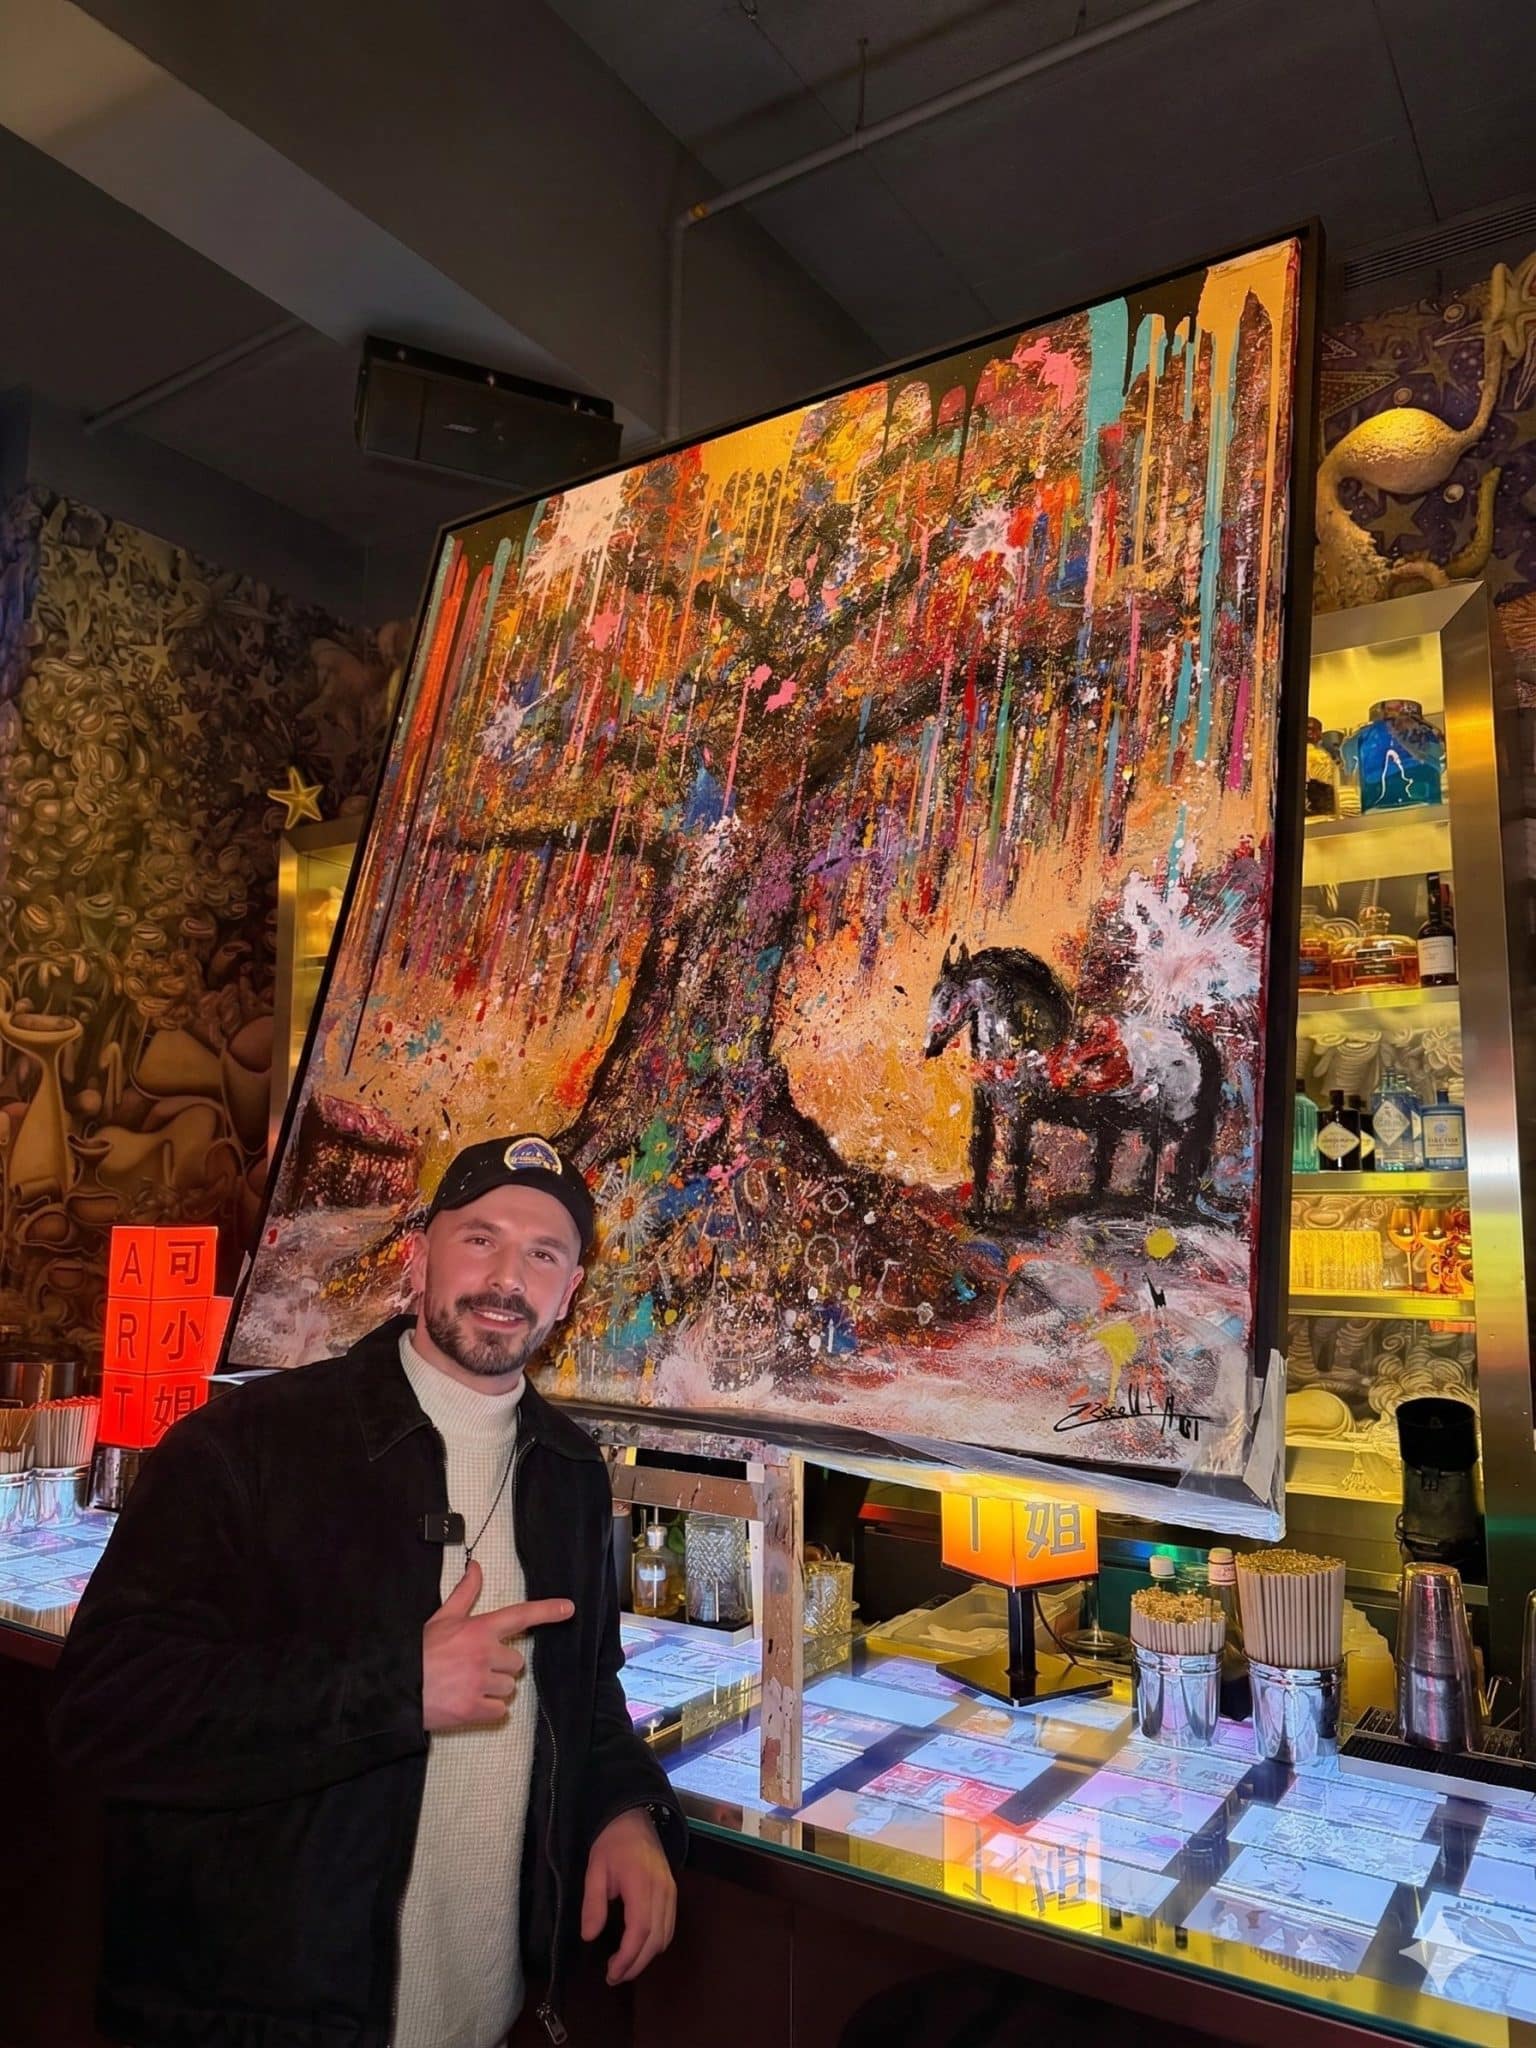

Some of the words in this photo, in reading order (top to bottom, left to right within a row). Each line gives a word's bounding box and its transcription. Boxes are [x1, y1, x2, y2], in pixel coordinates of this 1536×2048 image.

[113, 1242, 143, 1432] ART
[152, 1240, 206, 1433] 可小姐
